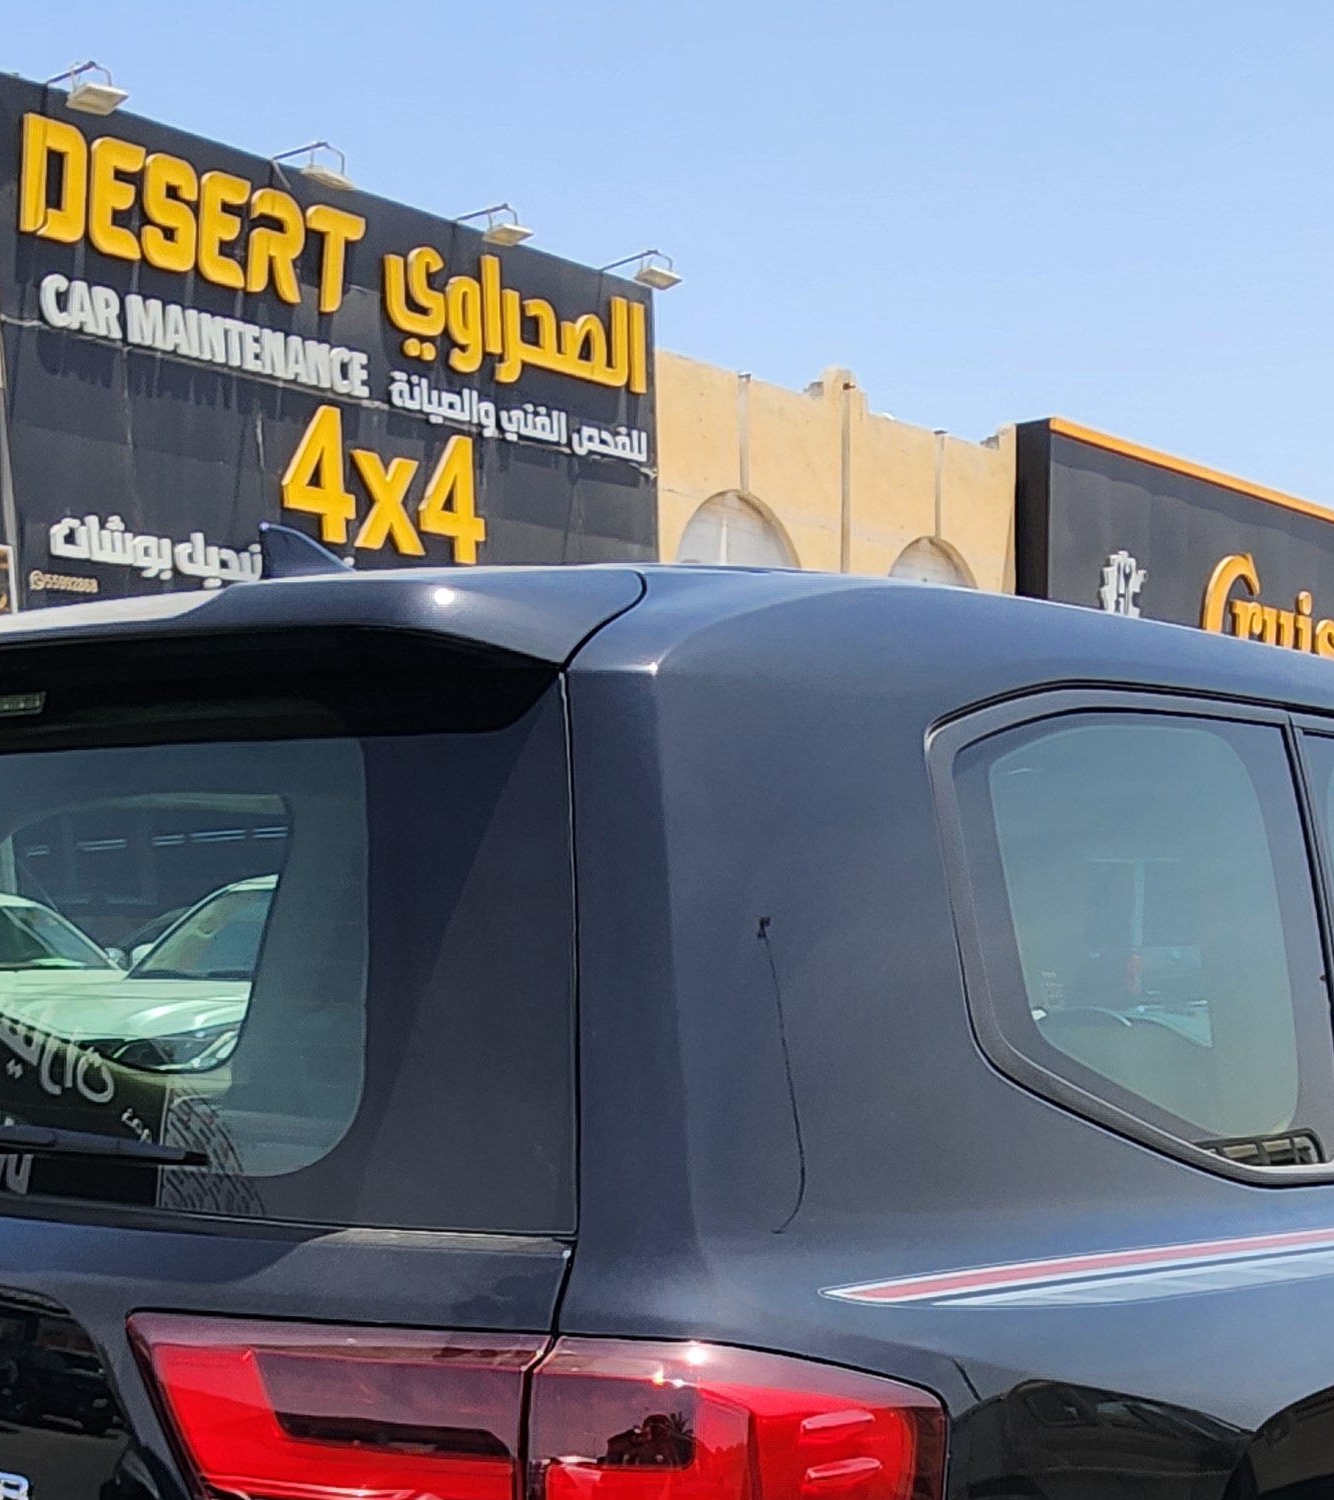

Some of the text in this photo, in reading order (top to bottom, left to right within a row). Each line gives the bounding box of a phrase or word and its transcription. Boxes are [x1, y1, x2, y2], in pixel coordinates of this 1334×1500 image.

[19, 112, 367, 313] DESERT
[40, 273, 371, 398] CAR MAINTENANCE
[383, 246, 647, 394] الصحراوي
[388, 370, 648, 463] للفحص الفني والصيانة
[49, 514, 173, 581] بوشات
[280, 405, 487, 565] 4x4
